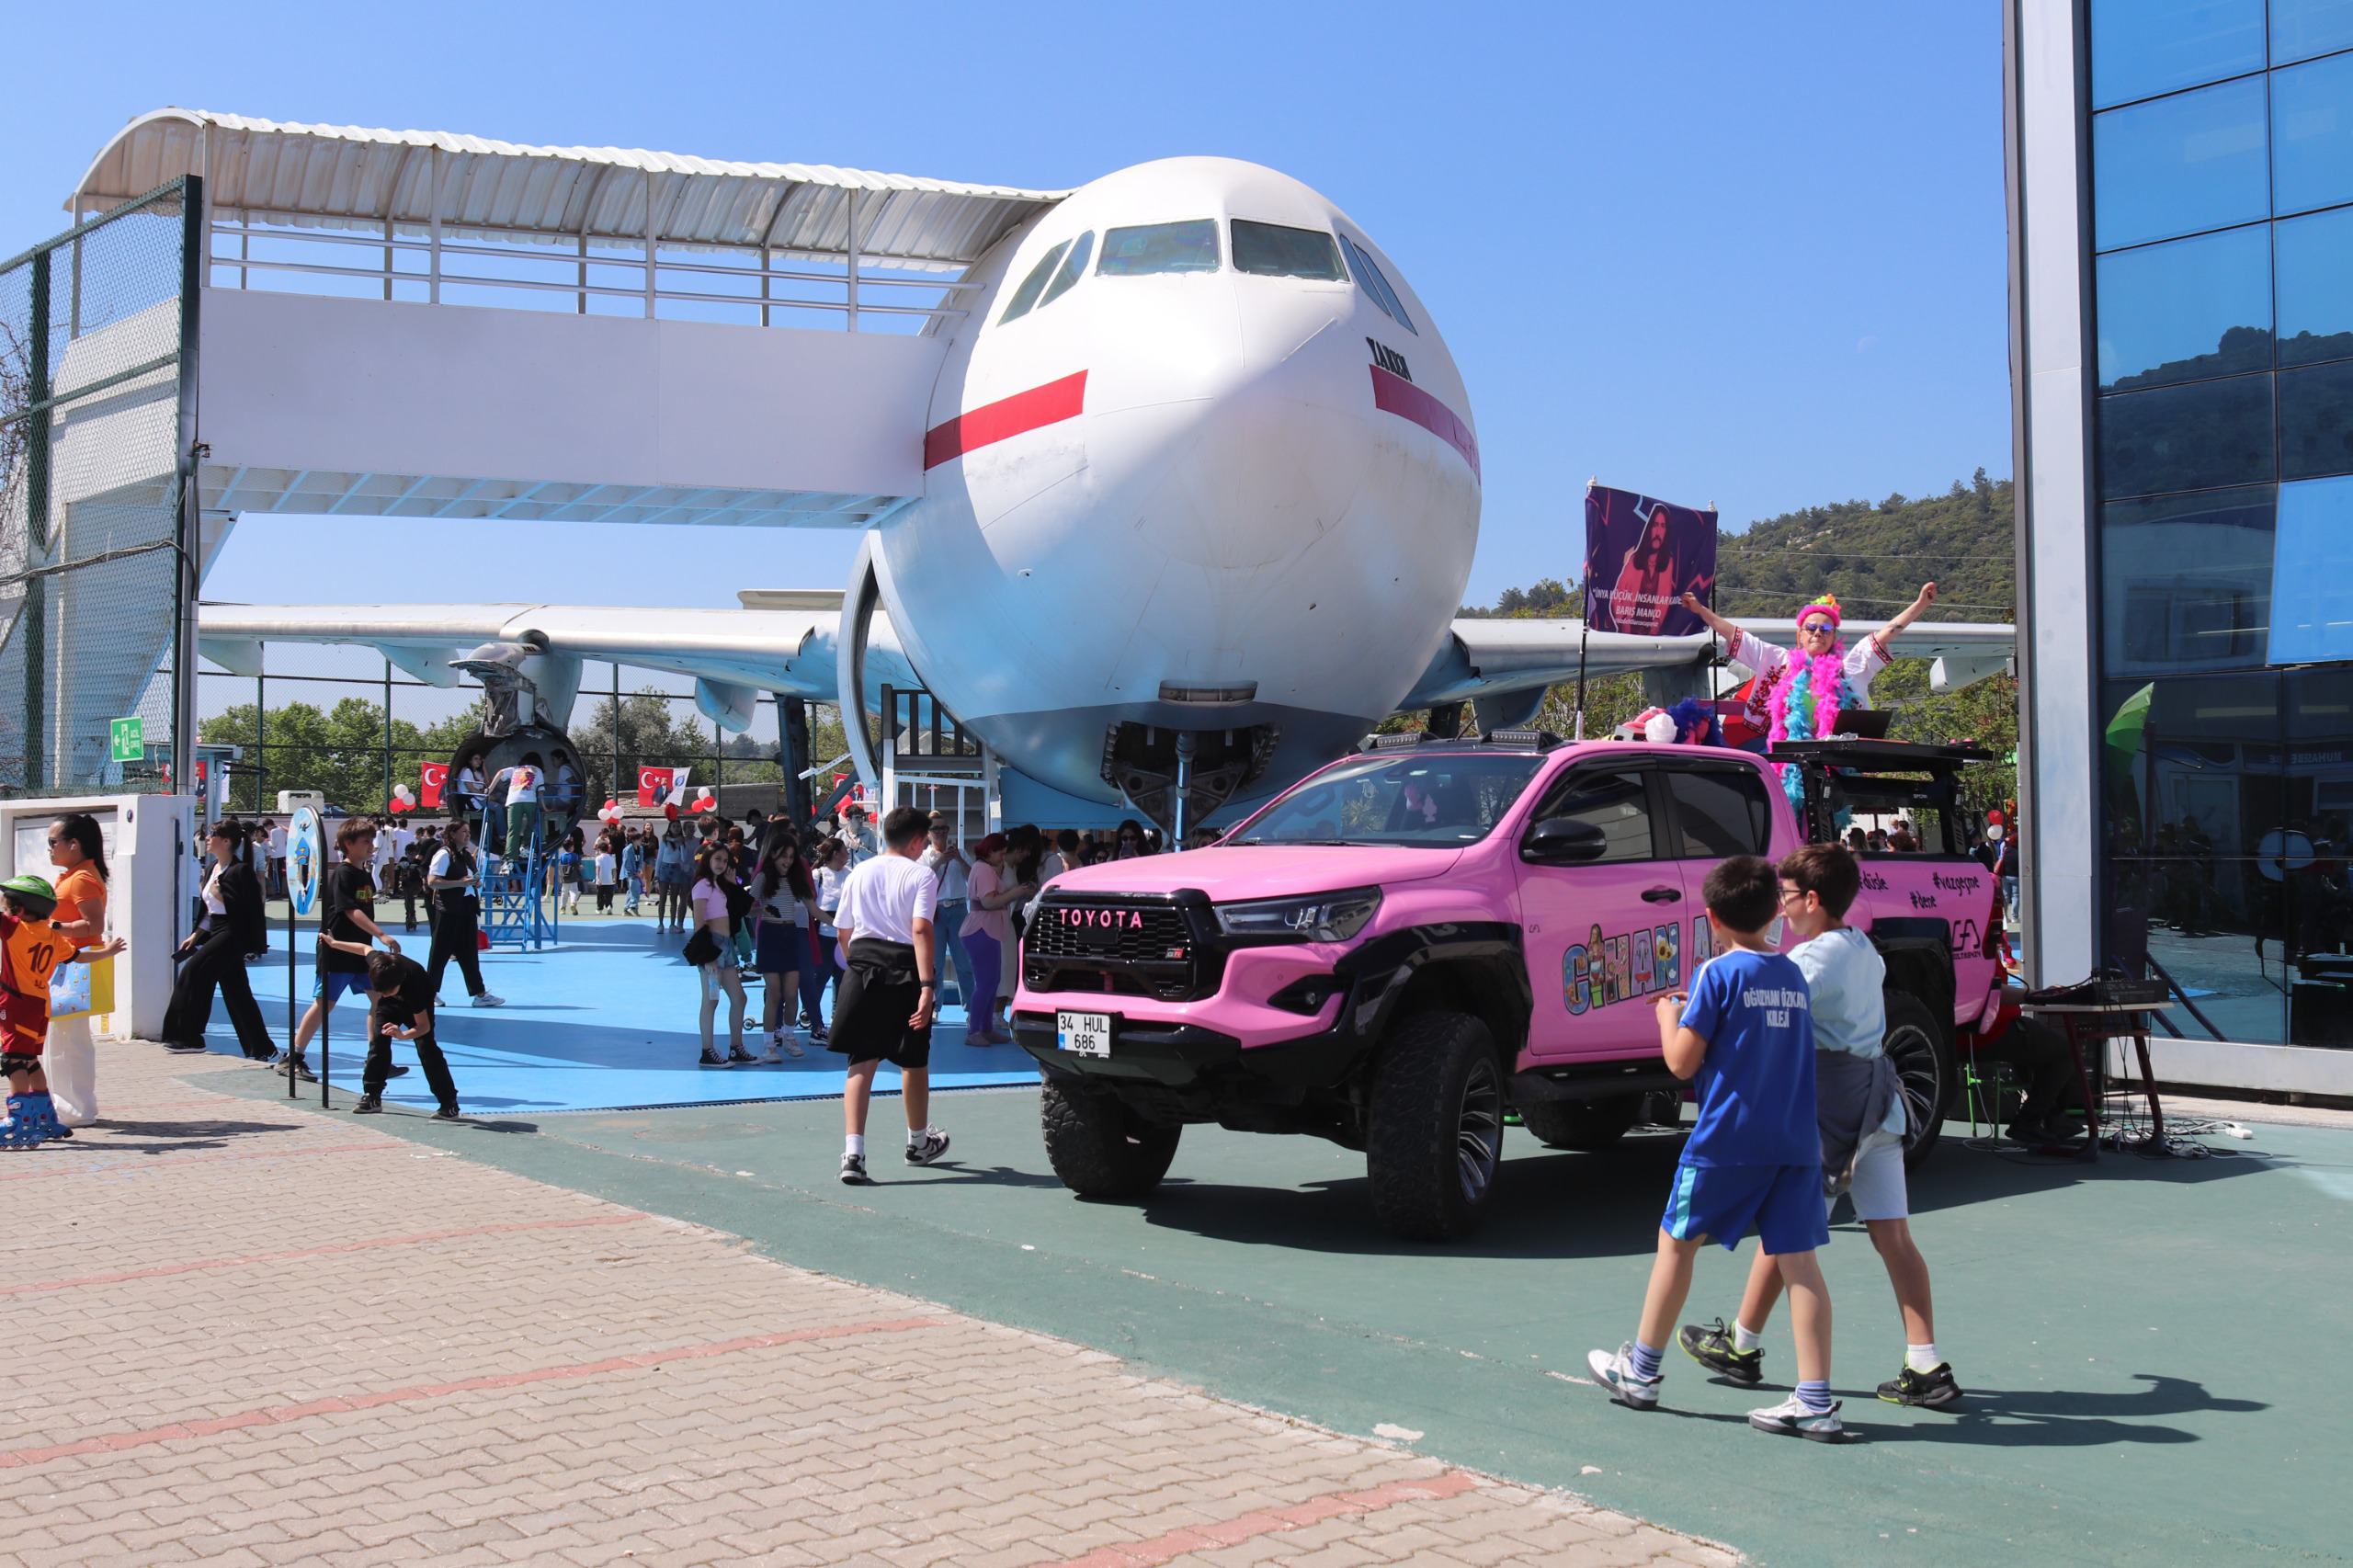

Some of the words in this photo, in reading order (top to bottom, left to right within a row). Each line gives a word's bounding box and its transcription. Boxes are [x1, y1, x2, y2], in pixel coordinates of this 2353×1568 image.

[1616, 606, 1634, 618] BARIŞ
[1636, 608, 1662, 619] MANÇO
[1910, 891, 1937, 909] #dene
[1060, 909, 1142, 928] TOYOTA
[28, 942, 54, 973] 10
[1060, 1015, 1074, 1029] 34
[1084, 1017, 1108, 1033] HUL
[1074, 1034, 1096, 1050] 686
